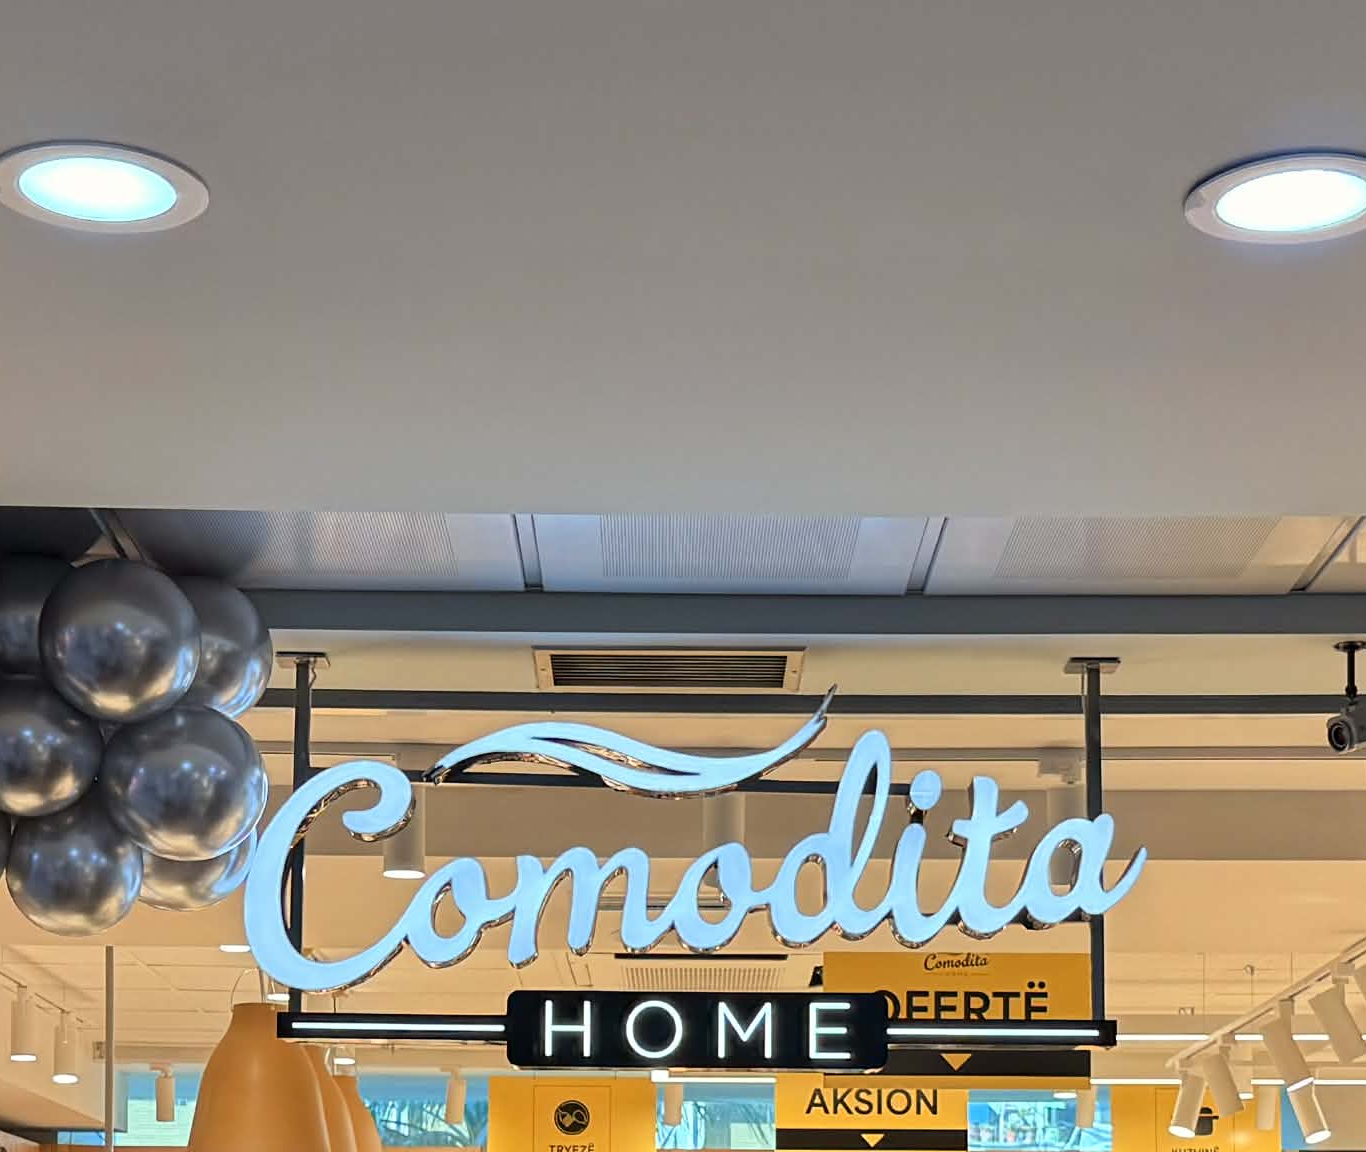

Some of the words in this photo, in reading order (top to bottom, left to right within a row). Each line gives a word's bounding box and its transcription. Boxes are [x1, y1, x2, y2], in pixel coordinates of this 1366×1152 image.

[244, 727, 1147, 994] Comodita
[923, 953, 989, 971] Comodita
[543, 1000, 852, 1060] HOME
[805, 1087, 938, 1115] AKSION
